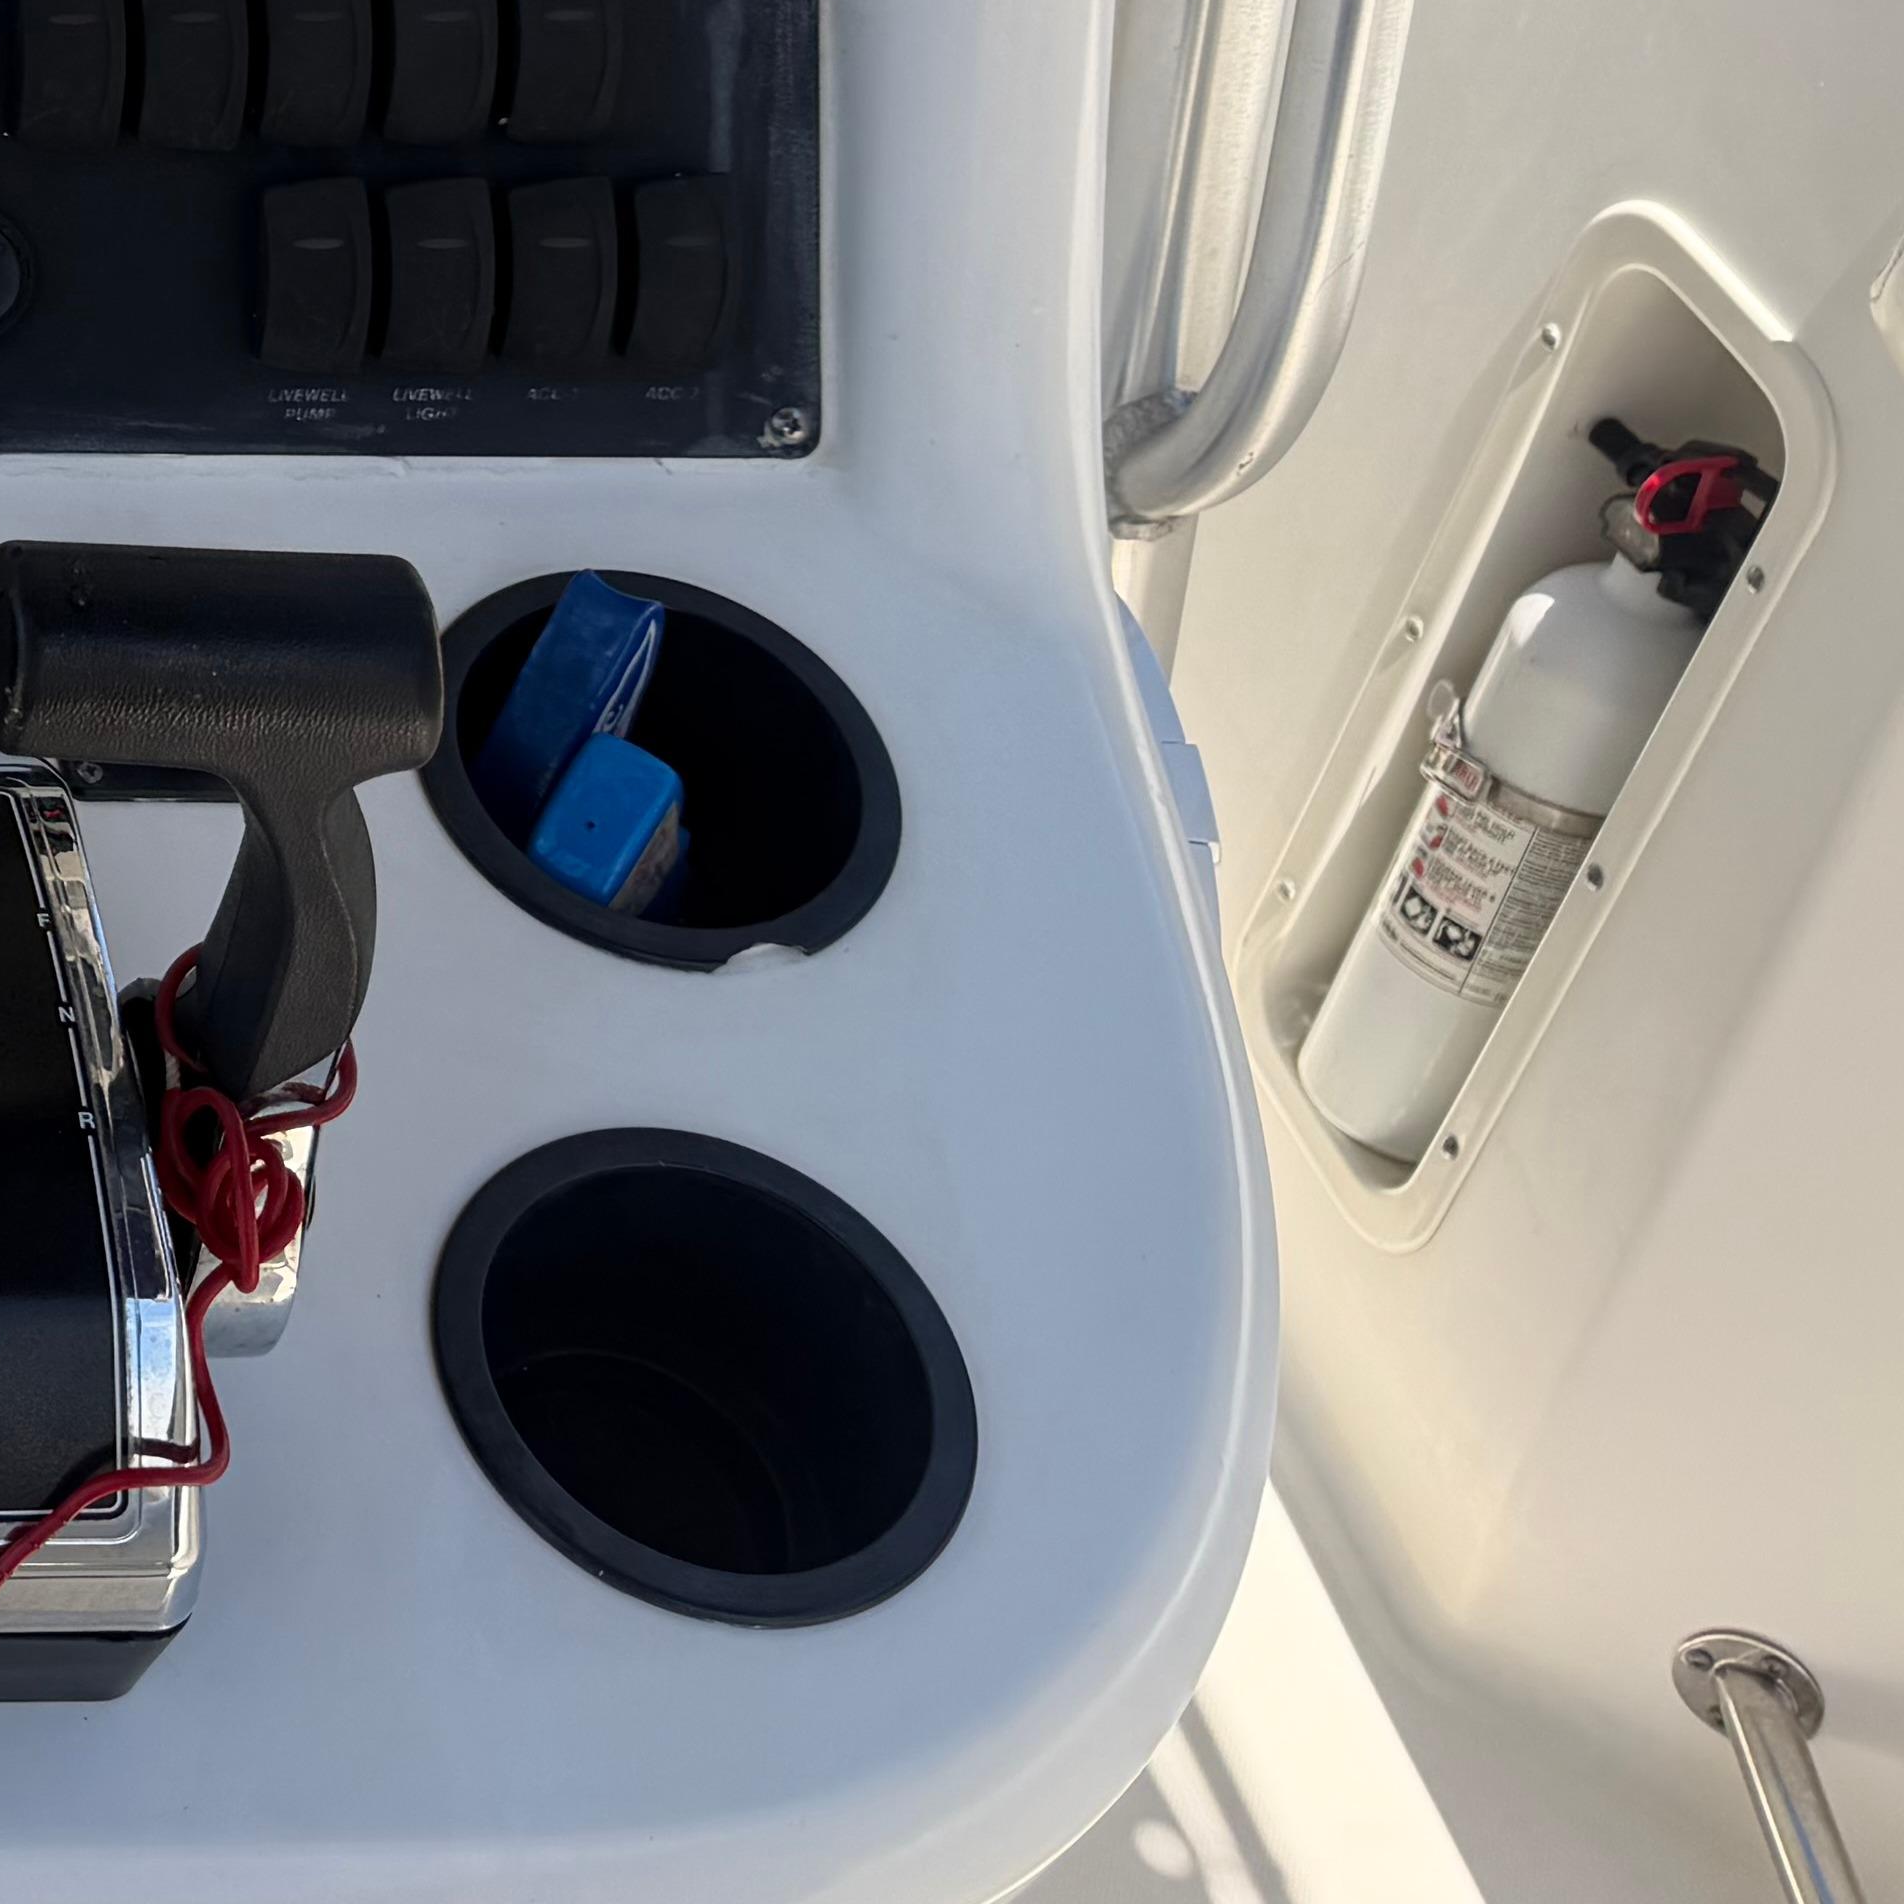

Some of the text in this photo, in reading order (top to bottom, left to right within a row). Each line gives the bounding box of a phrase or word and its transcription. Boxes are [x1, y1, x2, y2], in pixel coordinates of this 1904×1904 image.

[38, 912, 51, 929] F
[58, 1005, 76, 1023] N
[78, 1111, 95, 1130] R
